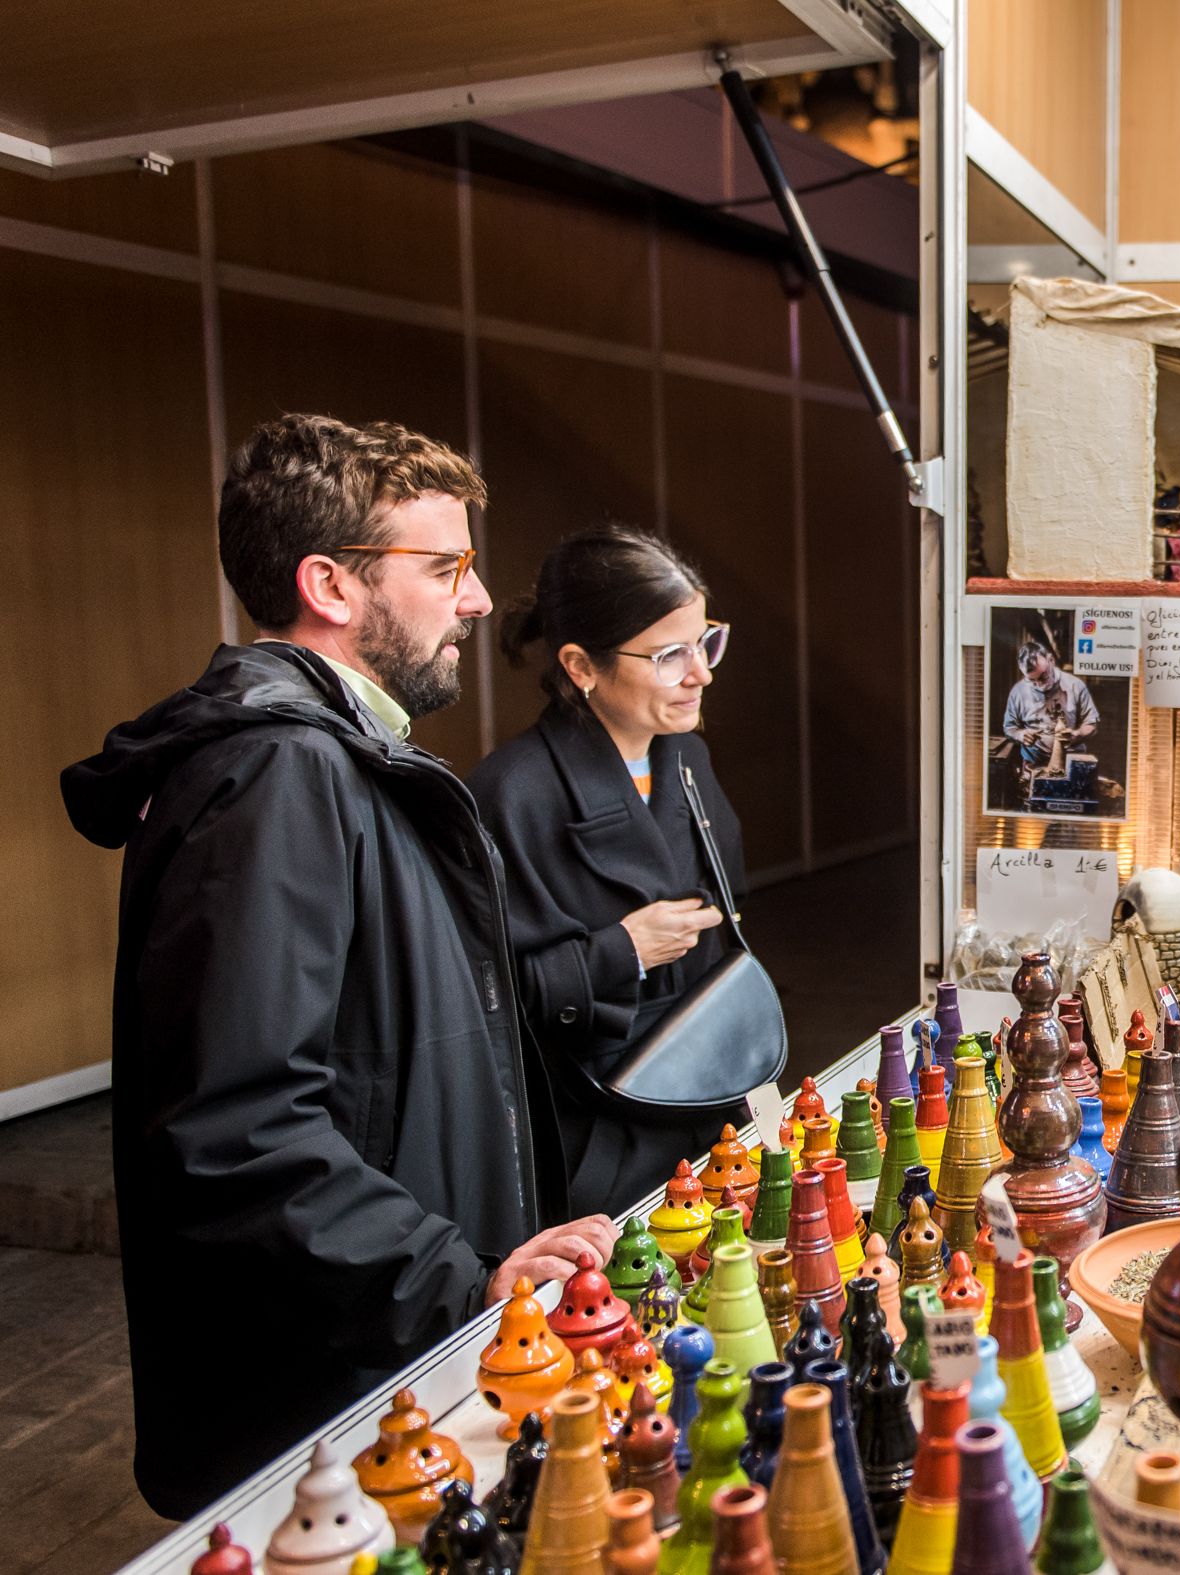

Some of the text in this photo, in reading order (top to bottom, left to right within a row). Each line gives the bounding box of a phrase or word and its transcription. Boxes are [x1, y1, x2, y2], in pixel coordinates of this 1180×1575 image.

[1082, 608, 1133, 619] ¡SÍGUENOS!
[1147, 628, 1180, 640] entre
[1147, 645, 1168, 657] pues
[1079, 662, 1133, 672] FOLLOW US!
[990, 851, 1054, 877] Arcilla
